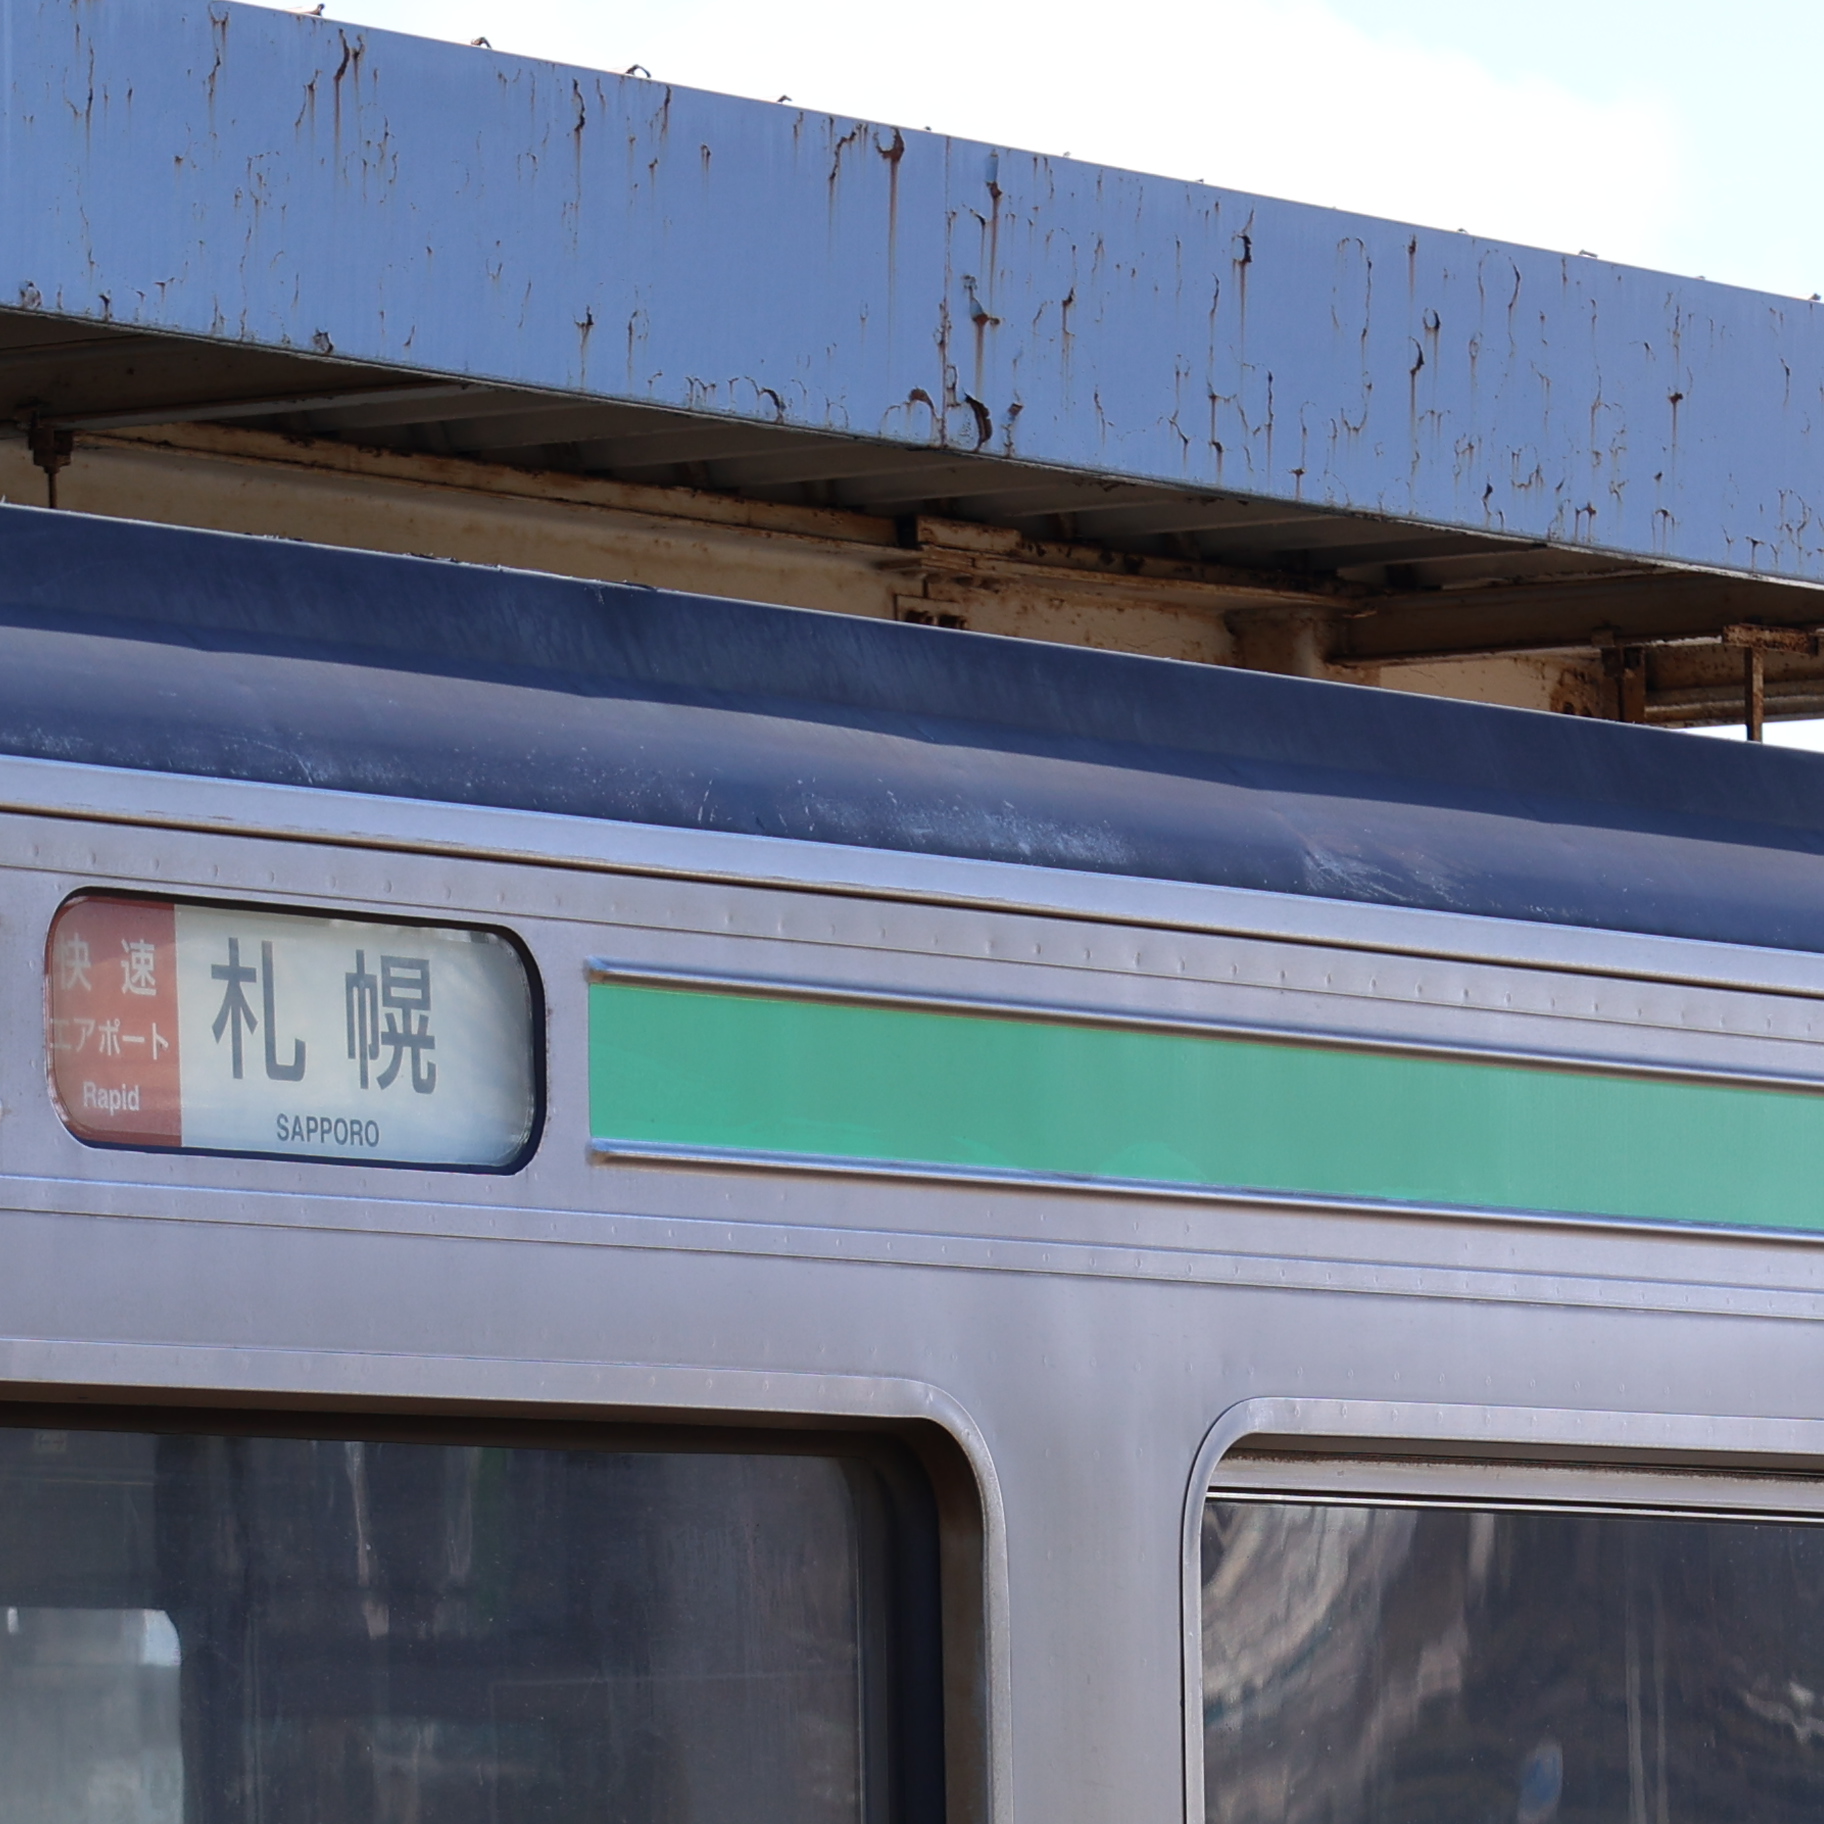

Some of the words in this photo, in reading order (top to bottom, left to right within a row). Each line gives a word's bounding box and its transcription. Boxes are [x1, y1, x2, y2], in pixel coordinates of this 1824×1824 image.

[53, 932, 157, 996] 快速
[210, 937, 437, 1095] 札幌
[50, 1017, 169, 1061] エアポート
[83, 1081, 140, 1116] Rapid
[275, 1112, 380, 1148] SAPPORO
